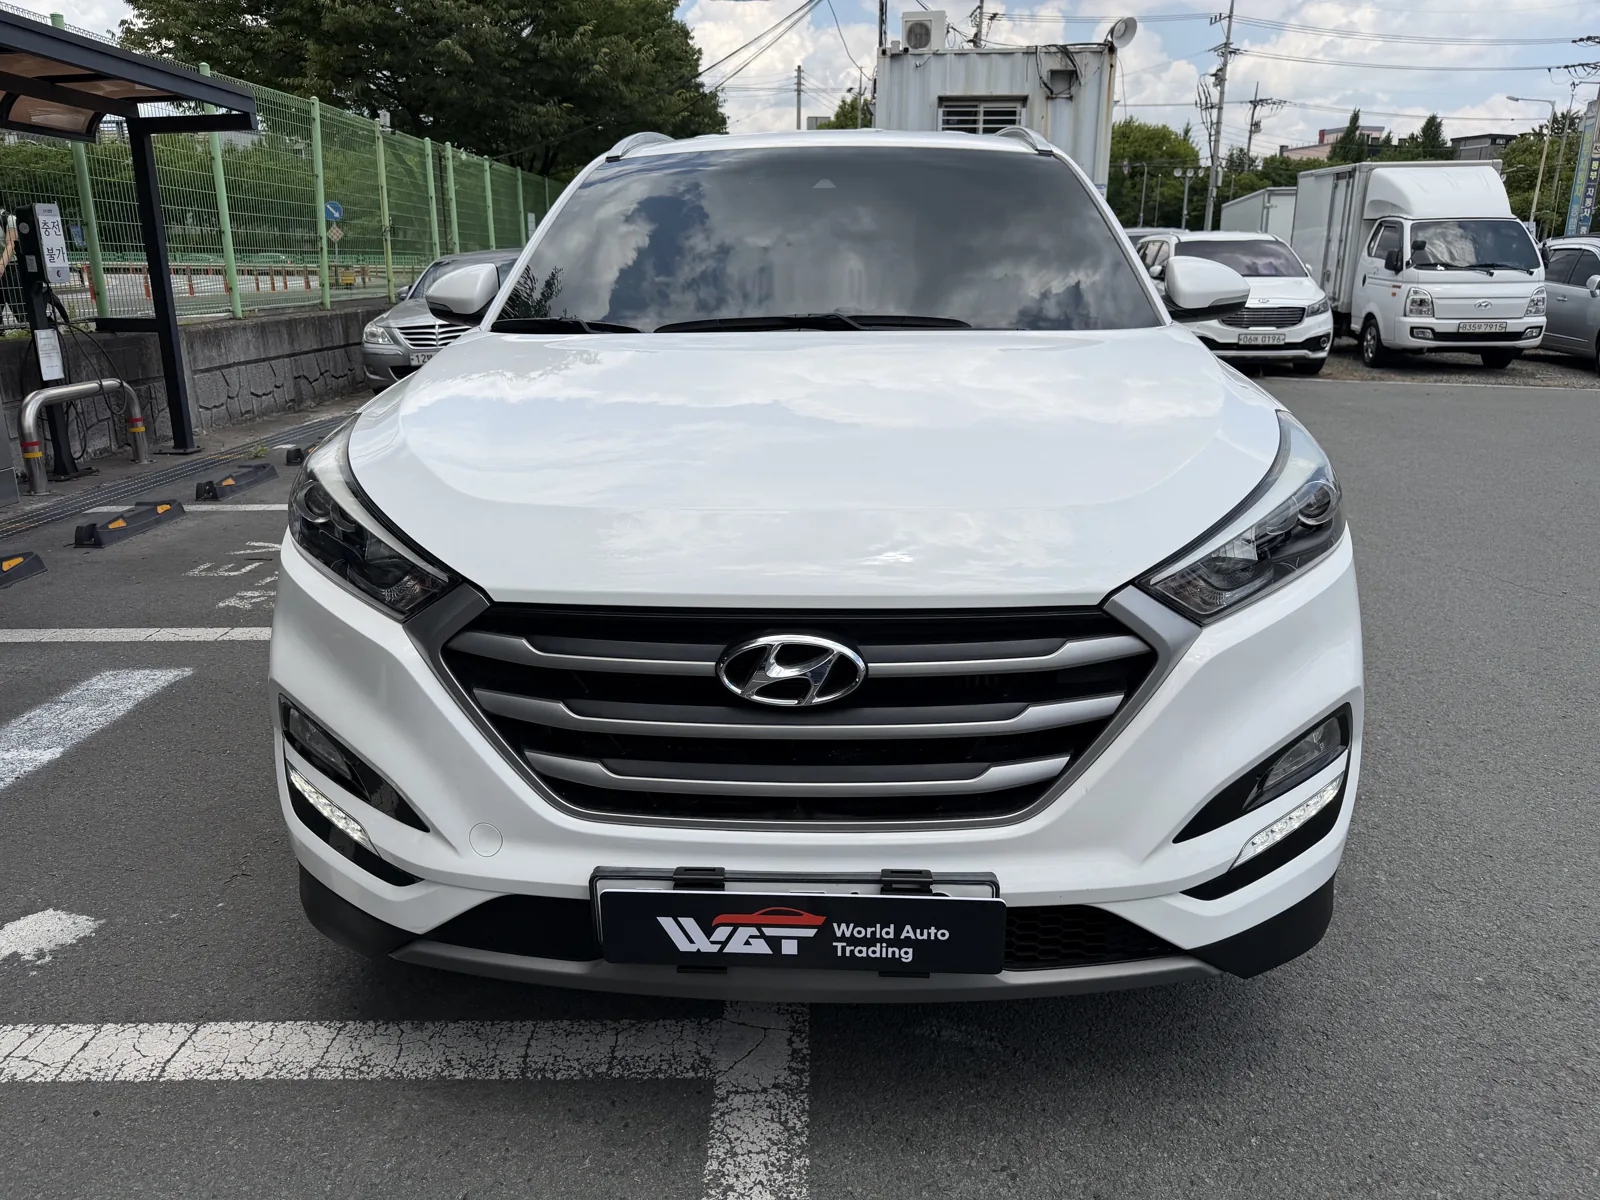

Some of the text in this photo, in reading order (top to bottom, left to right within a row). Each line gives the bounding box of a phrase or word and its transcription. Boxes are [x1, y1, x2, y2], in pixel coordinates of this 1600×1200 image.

[1583, 188, 1595, 217] 자동차
[41, 220, 61, 237] 충전
[46, 247, 66, 263] 불가
[656, 916, 818, 955] WAT
[832, 922, 950, 941] World Auto
[832, 941, 914, 963] Trading
